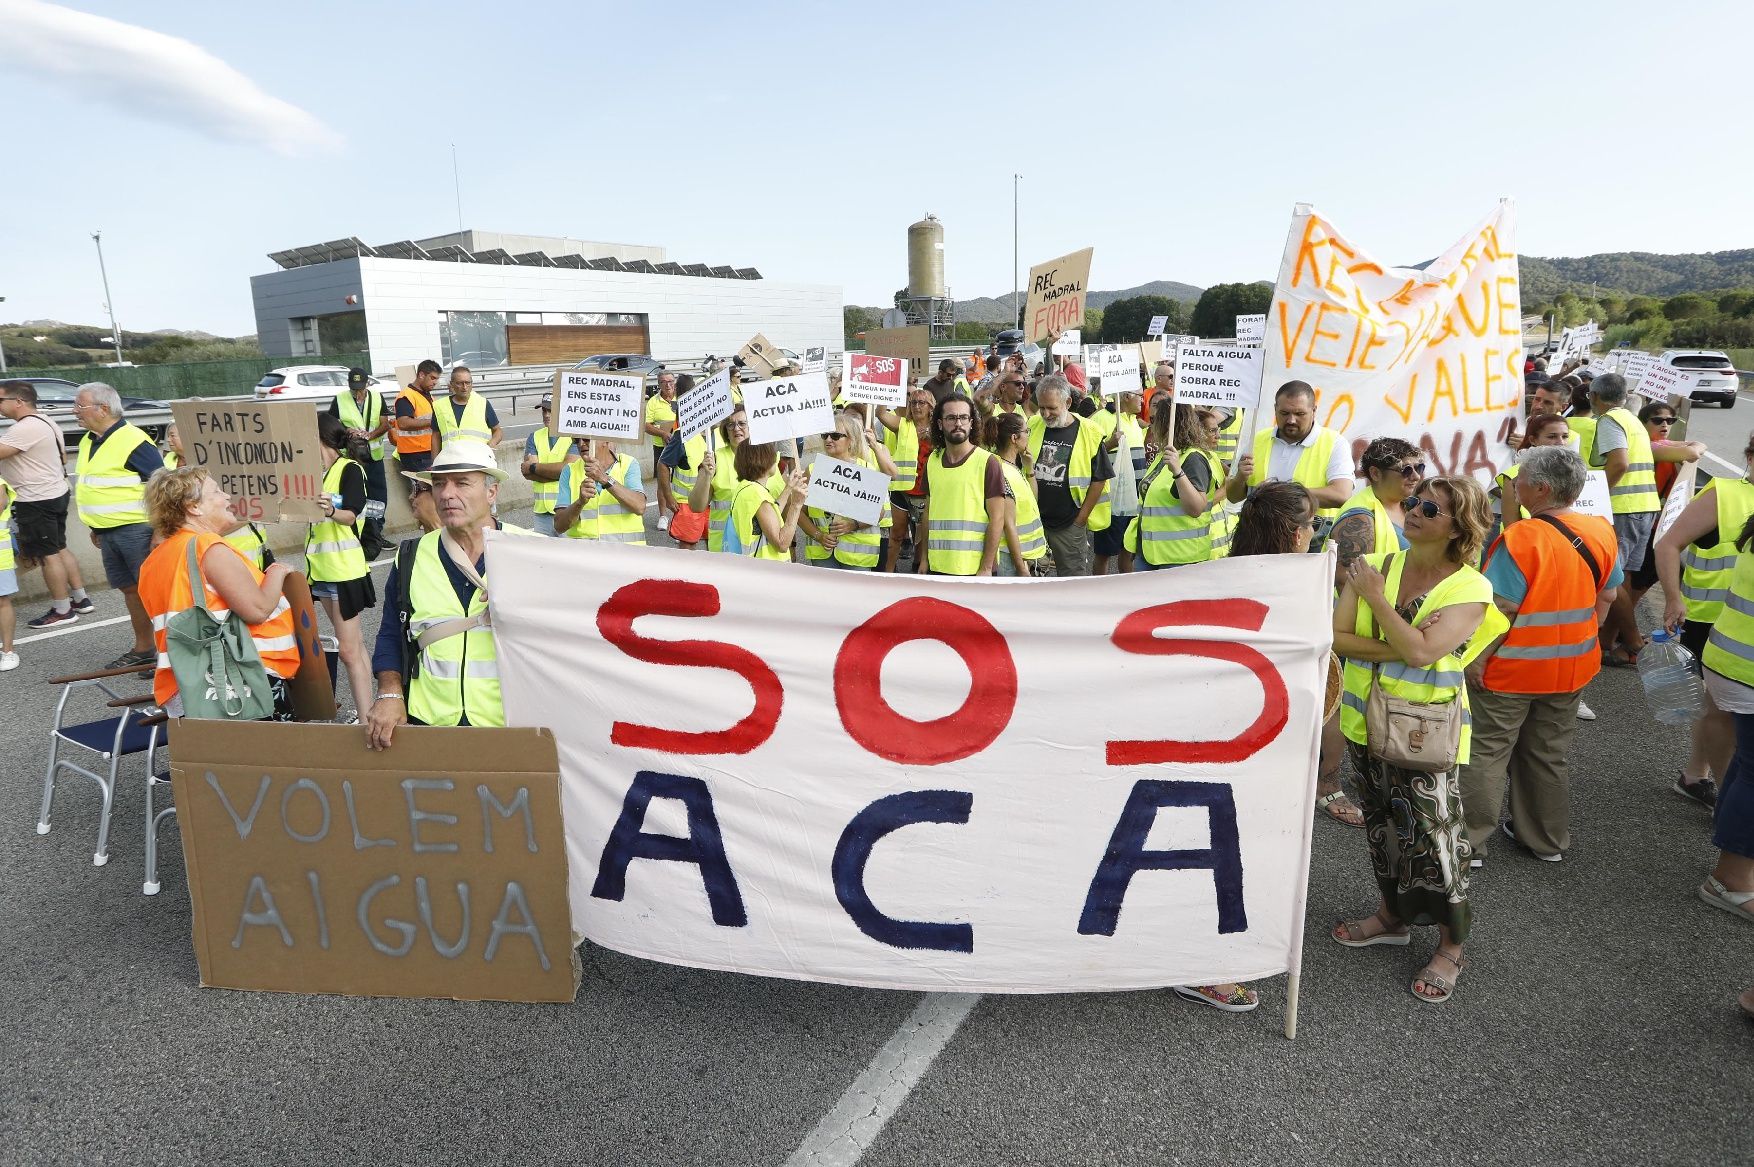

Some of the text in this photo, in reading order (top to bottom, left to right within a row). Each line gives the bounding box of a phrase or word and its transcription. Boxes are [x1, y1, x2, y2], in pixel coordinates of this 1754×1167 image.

[1034, 269, 1057, 294] REC
[1044, 281, 1081, 302] MADRAL
[1034, 296, 1078, 338] FORA
[1108, 355, 1122, 363] ACA
[1182, 348, 1214, 357] FALTA
[1217, 351, 1251, 359] AIGUA
[876, 359, 895, 374] SOS
[1652, 364, 1677, 376] L'AIGUA
[568, 376, 635, 390] REC MADRAL,
[1180, 376, 1240, 387] SOBRA REC
[1384, 348, 1520, 424] VALES
[568, 390, 621, 402] ENS ESTAS
[766, 382, 798, 398] ACA
[1180, 390, 1222, 400] MADRAL
[679, 395, 692, 407] REC
[680, 391, 714, 417] ENS ESTAS
[567, 405, 614, 416] AFOGANT
[622, 409, 638, 418] NO
[681, 404, 712, 428] AFOGANT
[716, 394, 728, 404] NO
[752, 404, 794, 418] ACTUA
[196, 412, 264, 434] FARTS
[566, 420, 630, 432] AMB AIGUA!!!
[682, 408, 725, 439] AMB AIGUA!!!
[832, 465, 861, 481] ACA
[815, 479, 850, 495] ACTUA
[595, 578, 1289, 766] SOS
[204, 770, 539, 854] VOLEM
[590, 770, 1247, 952] ACA
[230, 870, 550, 971] AIGUA
